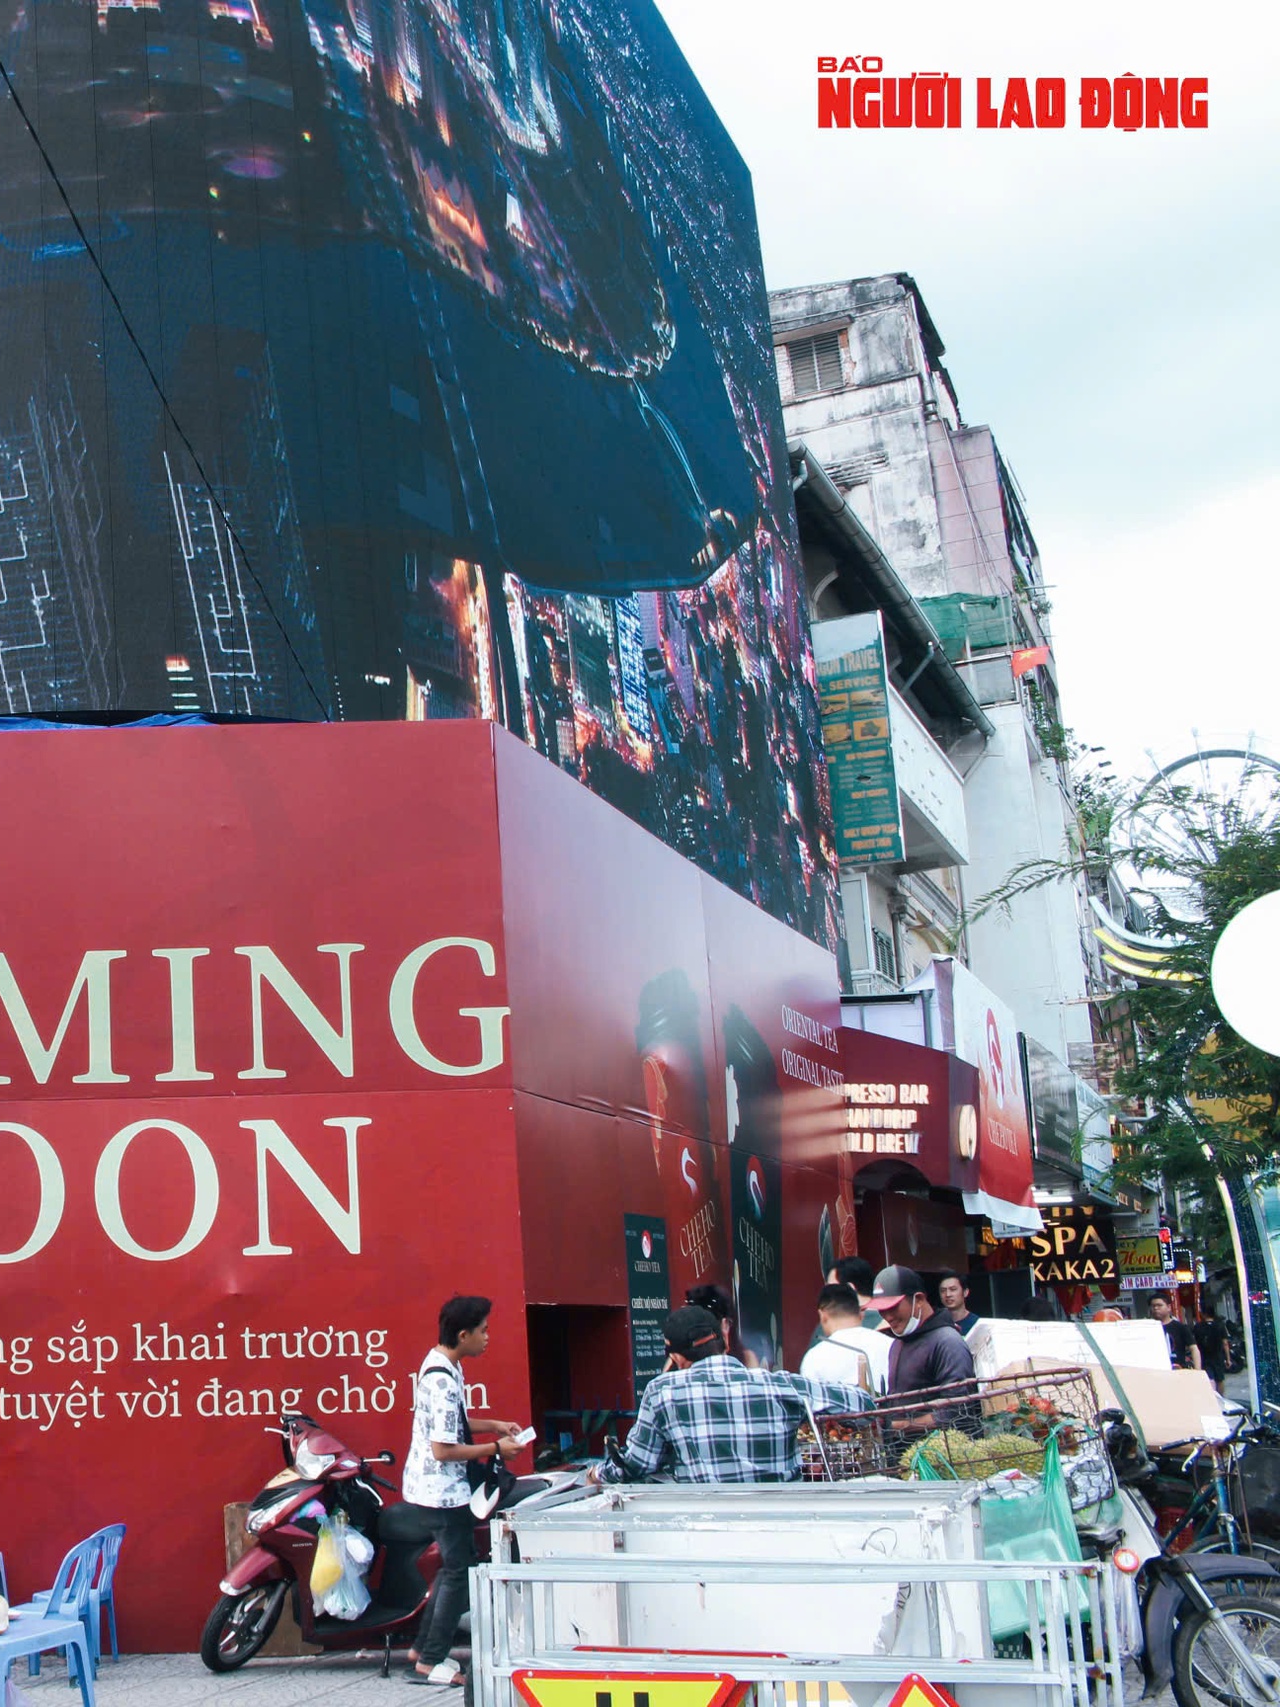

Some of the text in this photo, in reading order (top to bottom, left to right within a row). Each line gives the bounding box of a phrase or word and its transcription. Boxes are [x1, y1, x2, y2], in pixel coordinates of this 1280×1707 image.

[843, 648, 880, 673] TRAVEL
[830, 675, 880, 691] SERVICE
[781, 1004, 839, 1054] ORIENTAL TEA
[781, 1048, 822, 1087] ORIGINAL
[844, 1083, 930, 1105] PRESSO BAR
[846, 1132, 874, 1153] OLD
[680, 1200, 715, 1258] CHEHO
[739, 1216, 775, 1272] CHEHO
[1031, 1225, 1107, 1257] SPA
[691, 1236, 714, 1279] TEA
[1032, 1258, 1115, 1282] KAKA2
[1135, 1276, 1153, 1288] CARD
[47, 1319, 119, 1374] sắp
[132, 1322, 228, 1362] khai
[240, 1325, 389, 1367] trương
[117, 1378, 182, 1418] vời
[196, 1378, 303, 1416] đang
[317, 1372, 396, 1415] chờ
